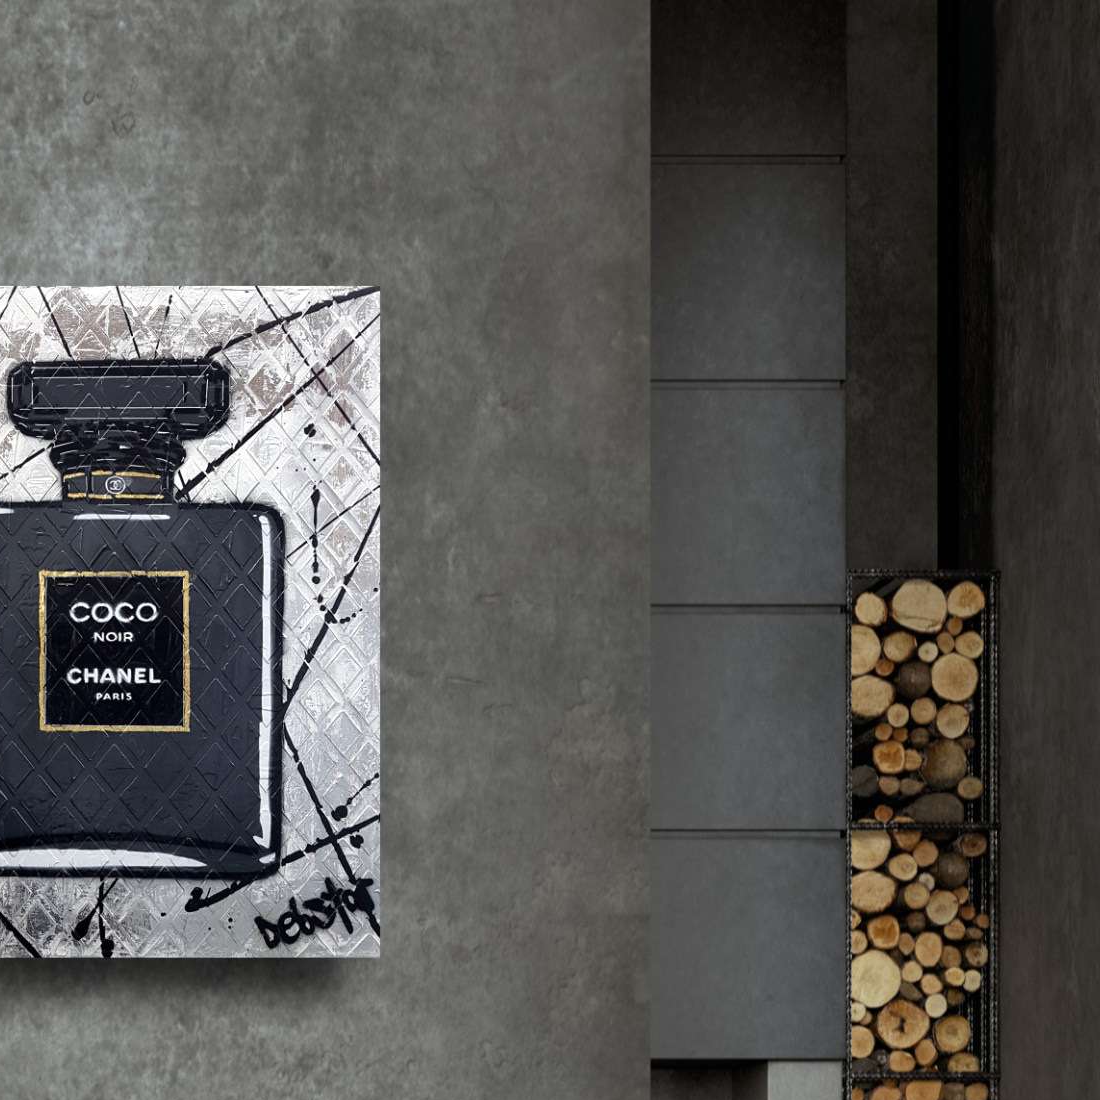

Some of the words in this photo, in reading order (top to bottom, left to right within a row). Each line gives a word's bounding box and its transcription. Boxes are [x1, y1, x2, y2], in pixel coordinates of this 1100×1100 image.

[69, 601, 159, 623] COCO
[93, 631, 134, 643] NOIR
[67, 667, 162, 685] CHANEL
[95, 692, 133, 701] PARIS
